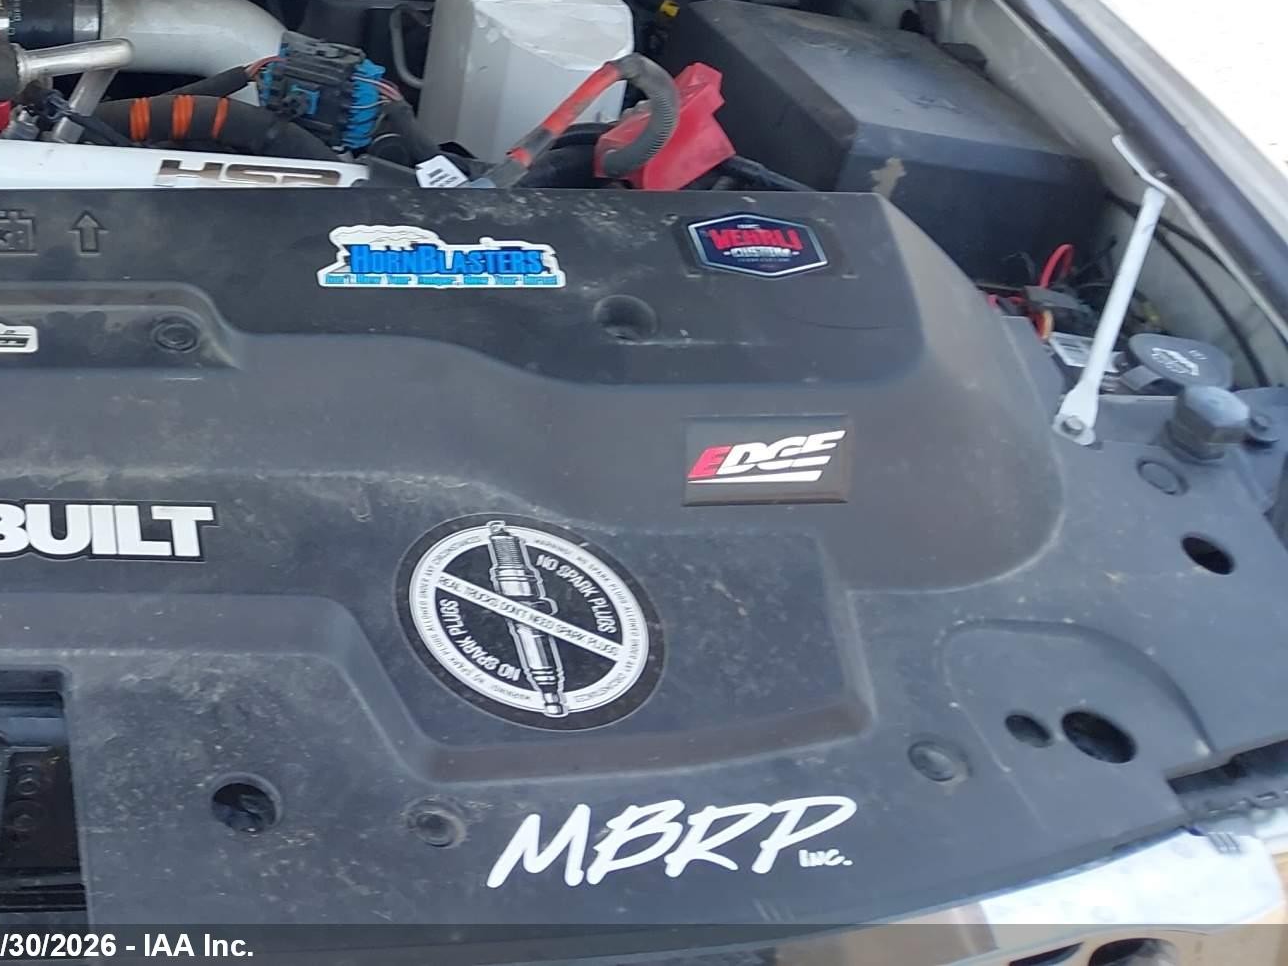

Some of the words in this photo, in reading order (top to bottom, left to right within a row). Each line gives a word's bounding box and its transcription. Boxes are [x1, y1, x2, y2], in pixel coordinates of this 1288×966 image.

[688, 430, 847, 478] EDGE
[536, 554, 559, 571] NO
[556, 564, 600, 598] SPARK
[587, 597, 617, 634] PLUGS
[439, 599, 469, 636] PLUGS
[454, 636, 500, 670] SPARK
[497, 663, 522, 681] NO
[486, 795, 858, 889] MBRP
